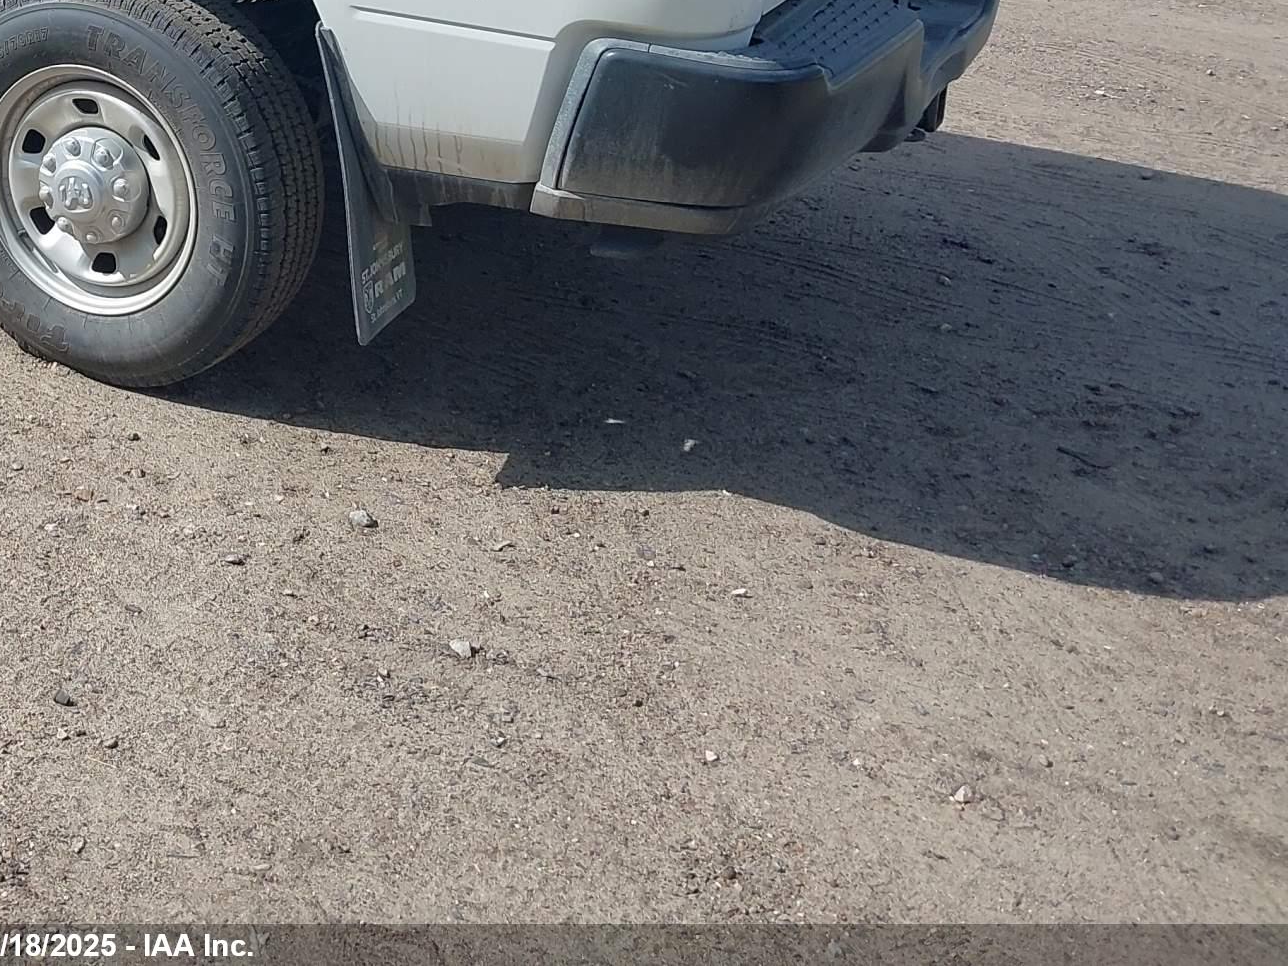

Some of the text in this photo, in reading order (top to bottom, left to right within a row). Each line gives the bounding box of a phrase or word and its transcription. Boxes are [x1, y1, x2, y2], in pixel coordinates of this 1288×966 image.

[86, 25, 236, 286] TRANSFORCE HT
[375, 261, 406, 298] RAM
